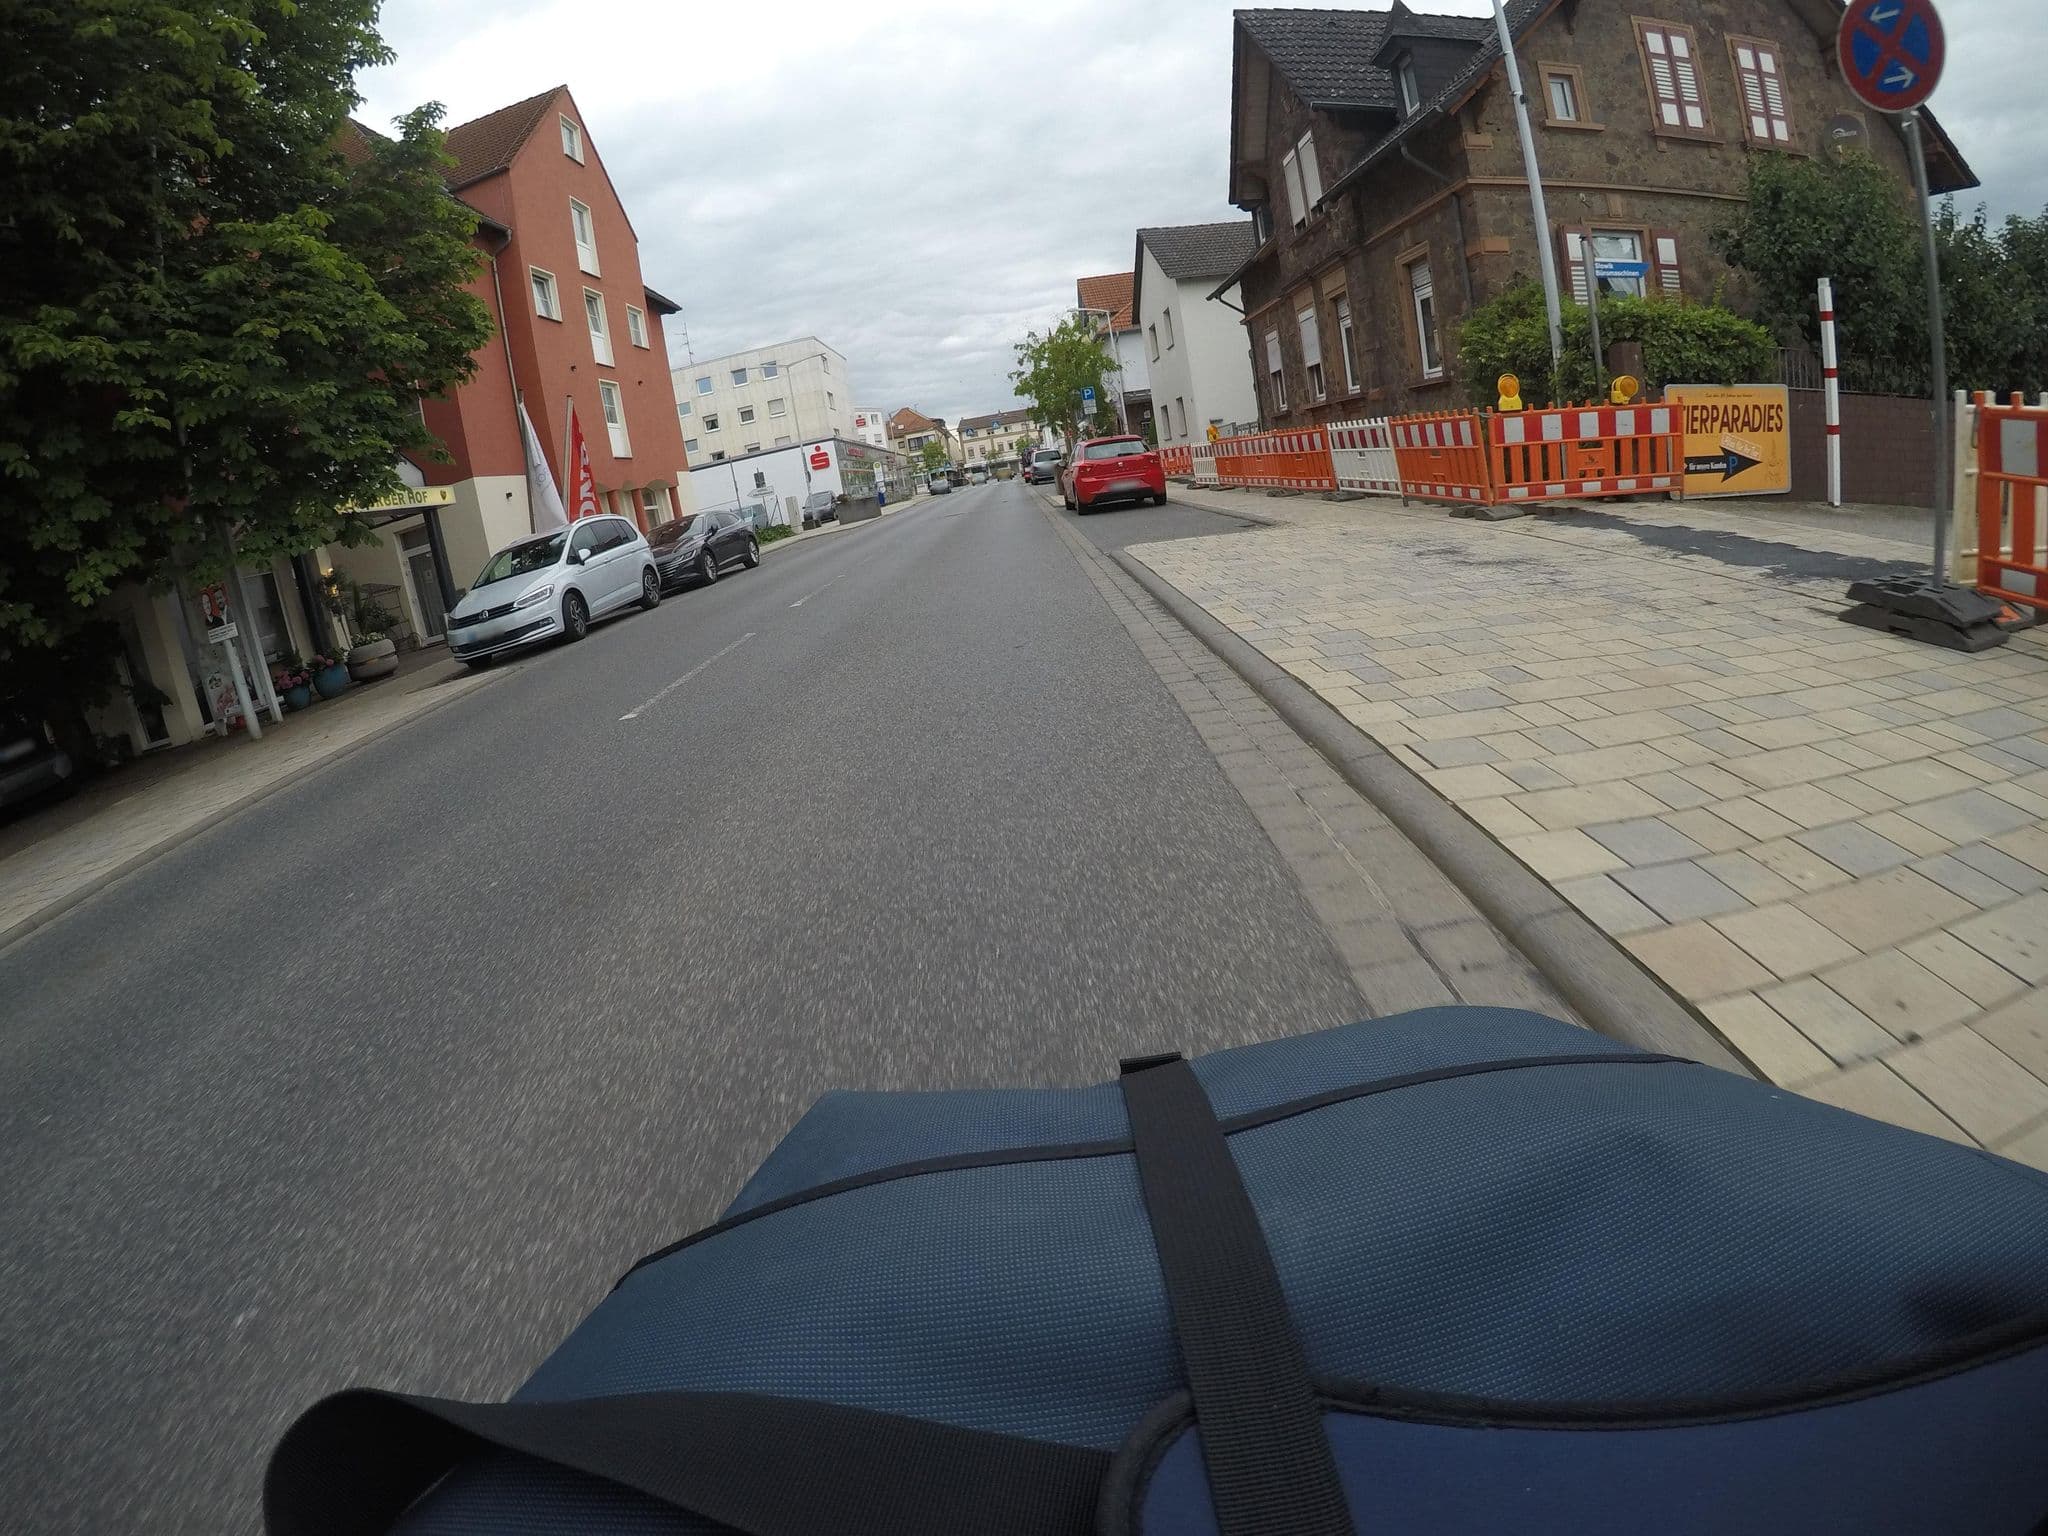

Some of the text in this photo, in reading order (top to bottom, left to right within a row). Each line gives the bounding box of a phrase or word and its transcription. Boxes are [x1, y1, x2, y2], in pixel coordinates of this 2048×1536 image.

[1084, 389, 1092, 399] P
[1683, 404, 1783, 434] IERPARADIES
[407, 491, 428, 505] HOF
